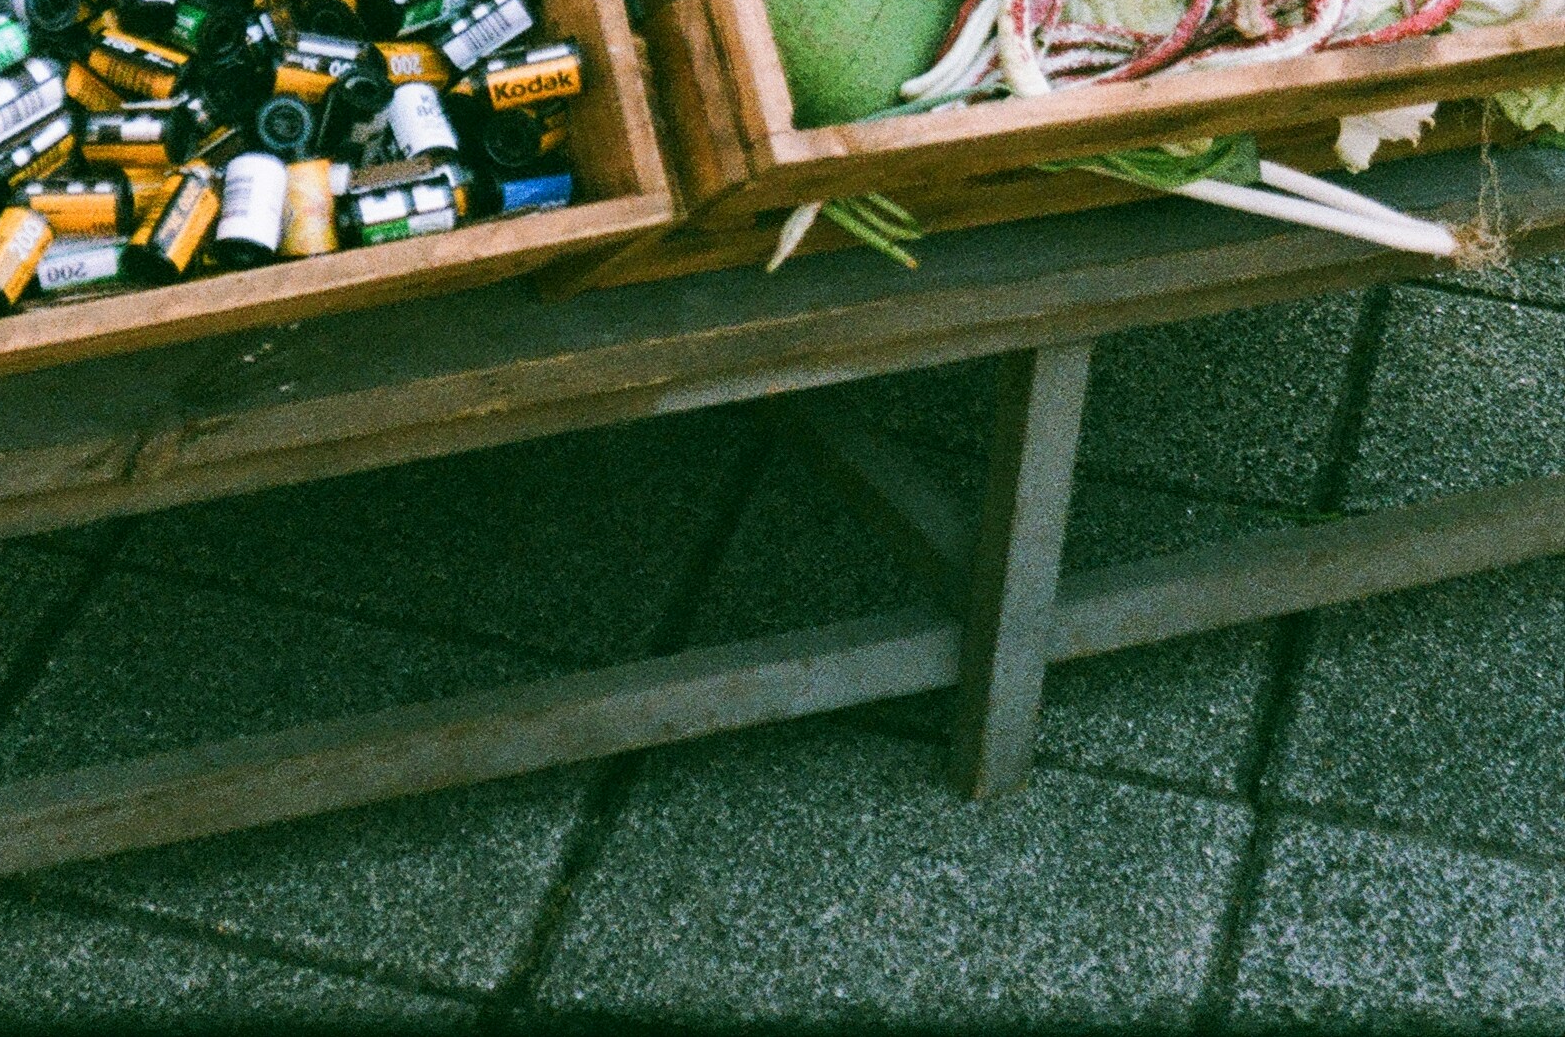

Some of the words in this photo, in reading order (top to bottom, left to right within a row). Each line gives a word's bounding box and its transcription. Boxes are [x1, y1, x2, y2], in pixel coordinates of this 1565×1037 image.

[389, 54, 423, 76] 200
[492, 69, 574, 101] Kodak
[8, 219, 46, 261] 200
[46, 262, 87, 284] 200
